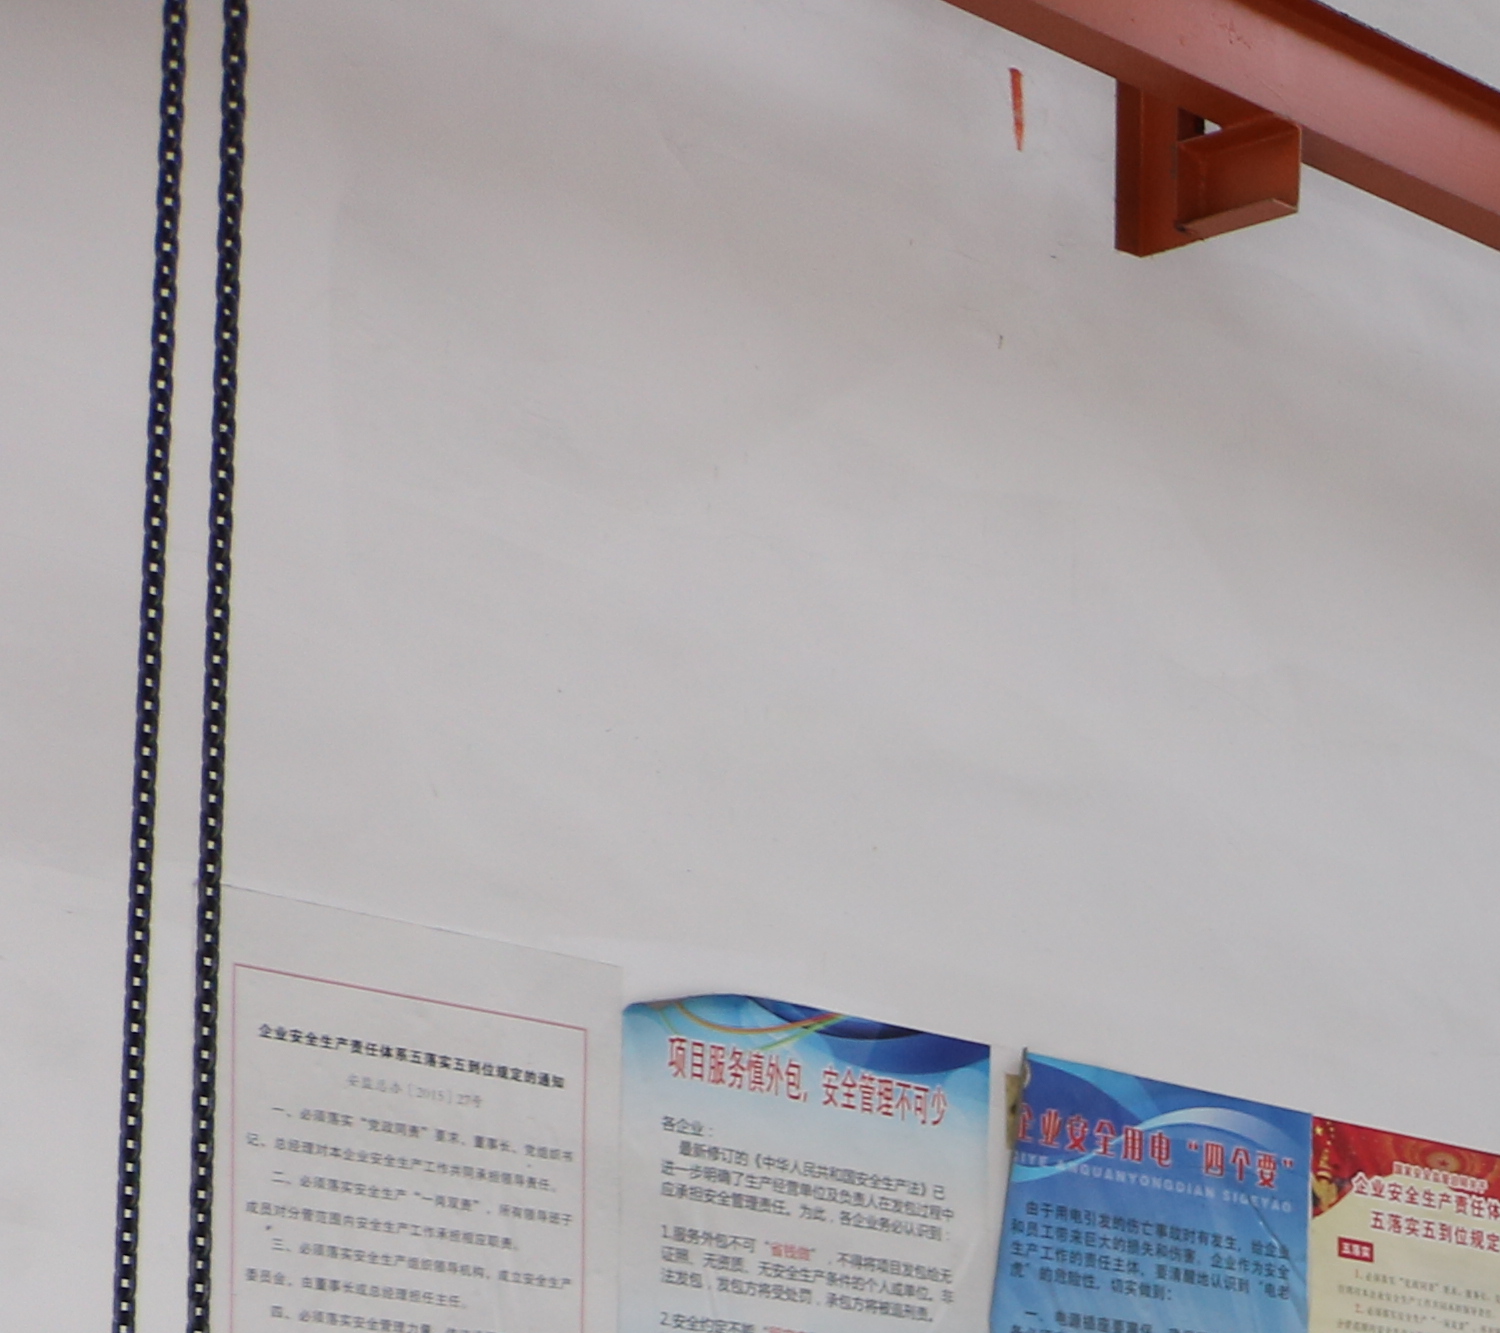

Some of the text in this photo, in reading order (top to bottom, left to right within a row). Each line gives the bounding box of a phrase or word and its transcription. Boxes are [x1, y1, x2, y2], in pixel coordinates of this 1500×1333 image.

[258, 1023, 565, 1089] 企业安全生产责任体系五落实五到位规定的通知
[1370, 1210, 1500, 1253] 五落实五到位规定
